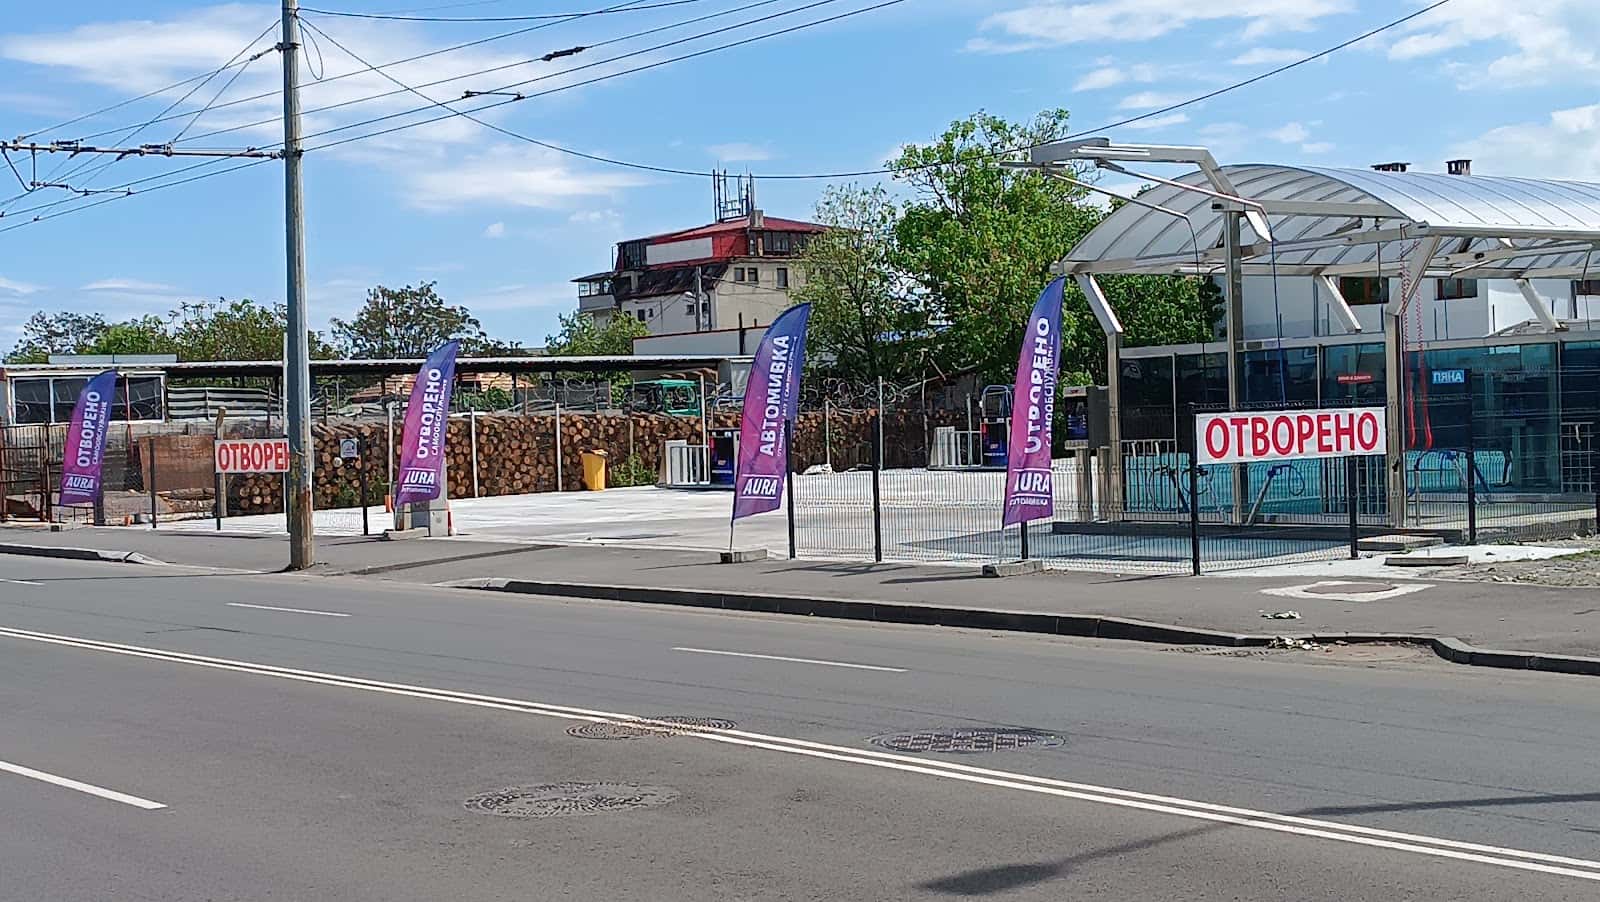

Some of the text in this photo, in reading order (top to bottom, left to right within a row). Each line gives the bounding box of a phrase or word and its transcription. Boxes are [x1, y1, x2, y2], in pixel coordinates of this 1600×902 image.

[759, 335, 790, 457] АВТОМИВКА
[1433, 370, 1463, 383] ПЯНА
[77, 391, 101, 467] ОТВОРЕНО
[416, 368, 442, 459] ОТВОРЕНО
[1205, 411, 1379, 460] ОТВОРЕНО
[65, 476, 94, 489] AURA
[742, 478, 778, 495] AURA
